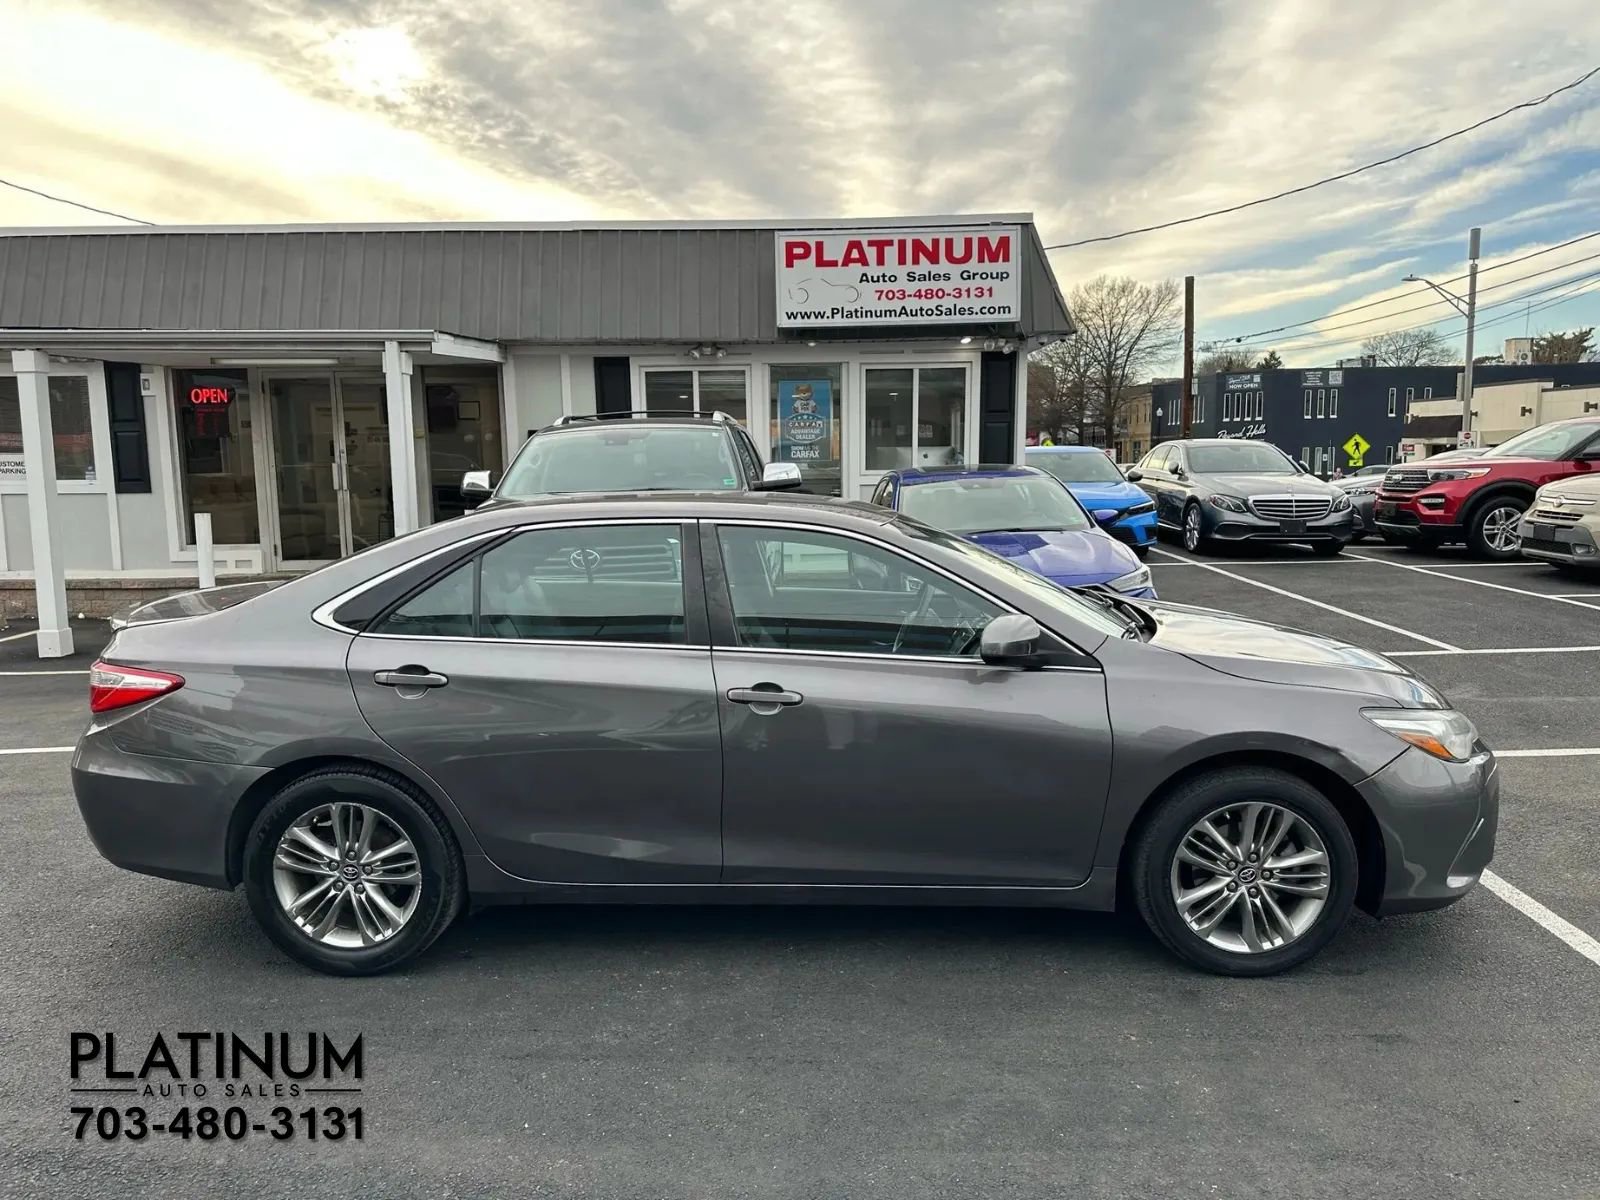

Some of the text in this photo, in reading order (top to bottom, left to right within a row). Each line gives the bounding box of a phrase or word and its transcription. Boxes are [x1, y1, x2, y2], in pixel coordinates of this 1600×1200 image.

[784, 236, 1010, 268] PLATINUM
[858, 269, 1010, 284] Auto Sales Group
[874, 286, 994, 301] 703-480-3131
[785, 304, 1011, 320] www.PlatinumAutoSales.com
[191, 388, 228, 404] OPEN
[791, 450, 820, 458] CARFAX
